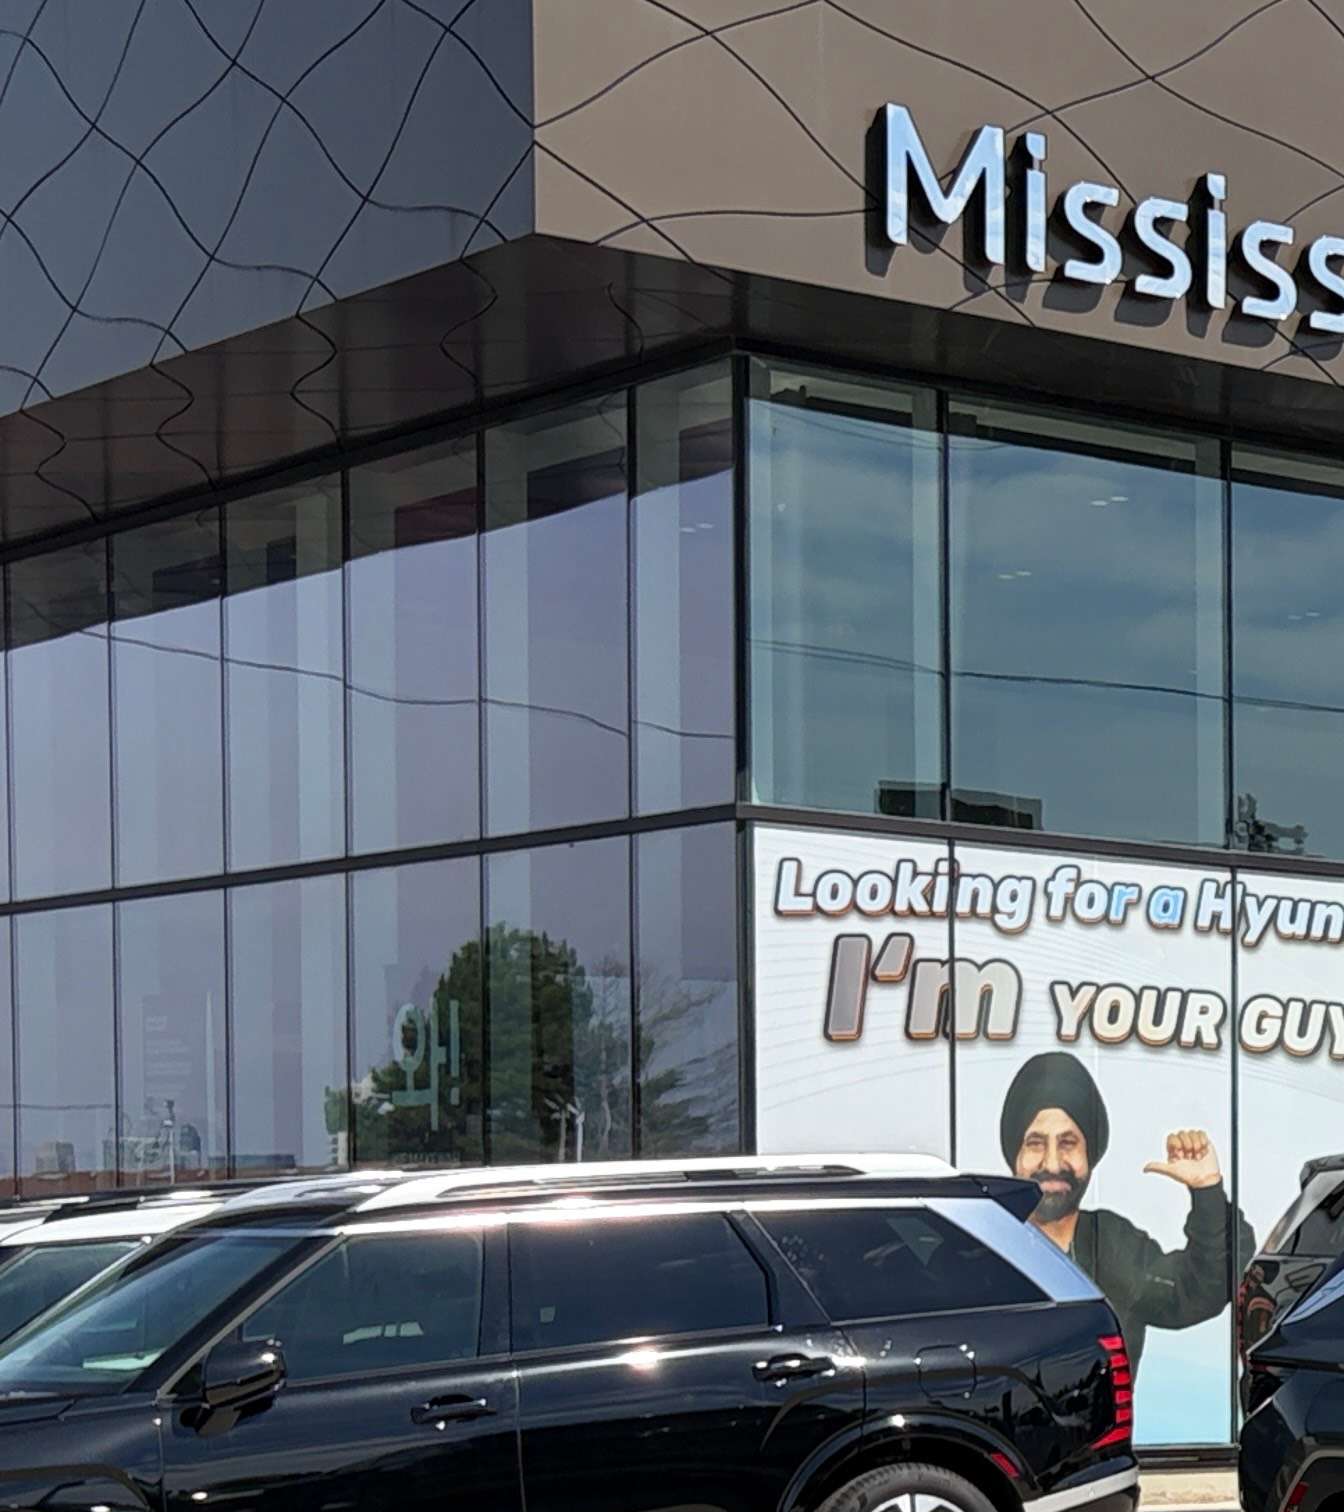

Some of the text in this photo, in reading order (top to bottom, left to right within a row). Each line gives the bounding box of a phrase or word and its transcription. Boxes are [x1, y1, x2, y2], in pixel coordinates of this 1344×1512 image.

[775, 858, 1036, 934] Looking
[1046, 865, 1140, 926] for
[1147, 886, 1187, 929] a
[824, 933, 1023, 1042] I'm
[1050, 980, 1228, 1050] YOUR
